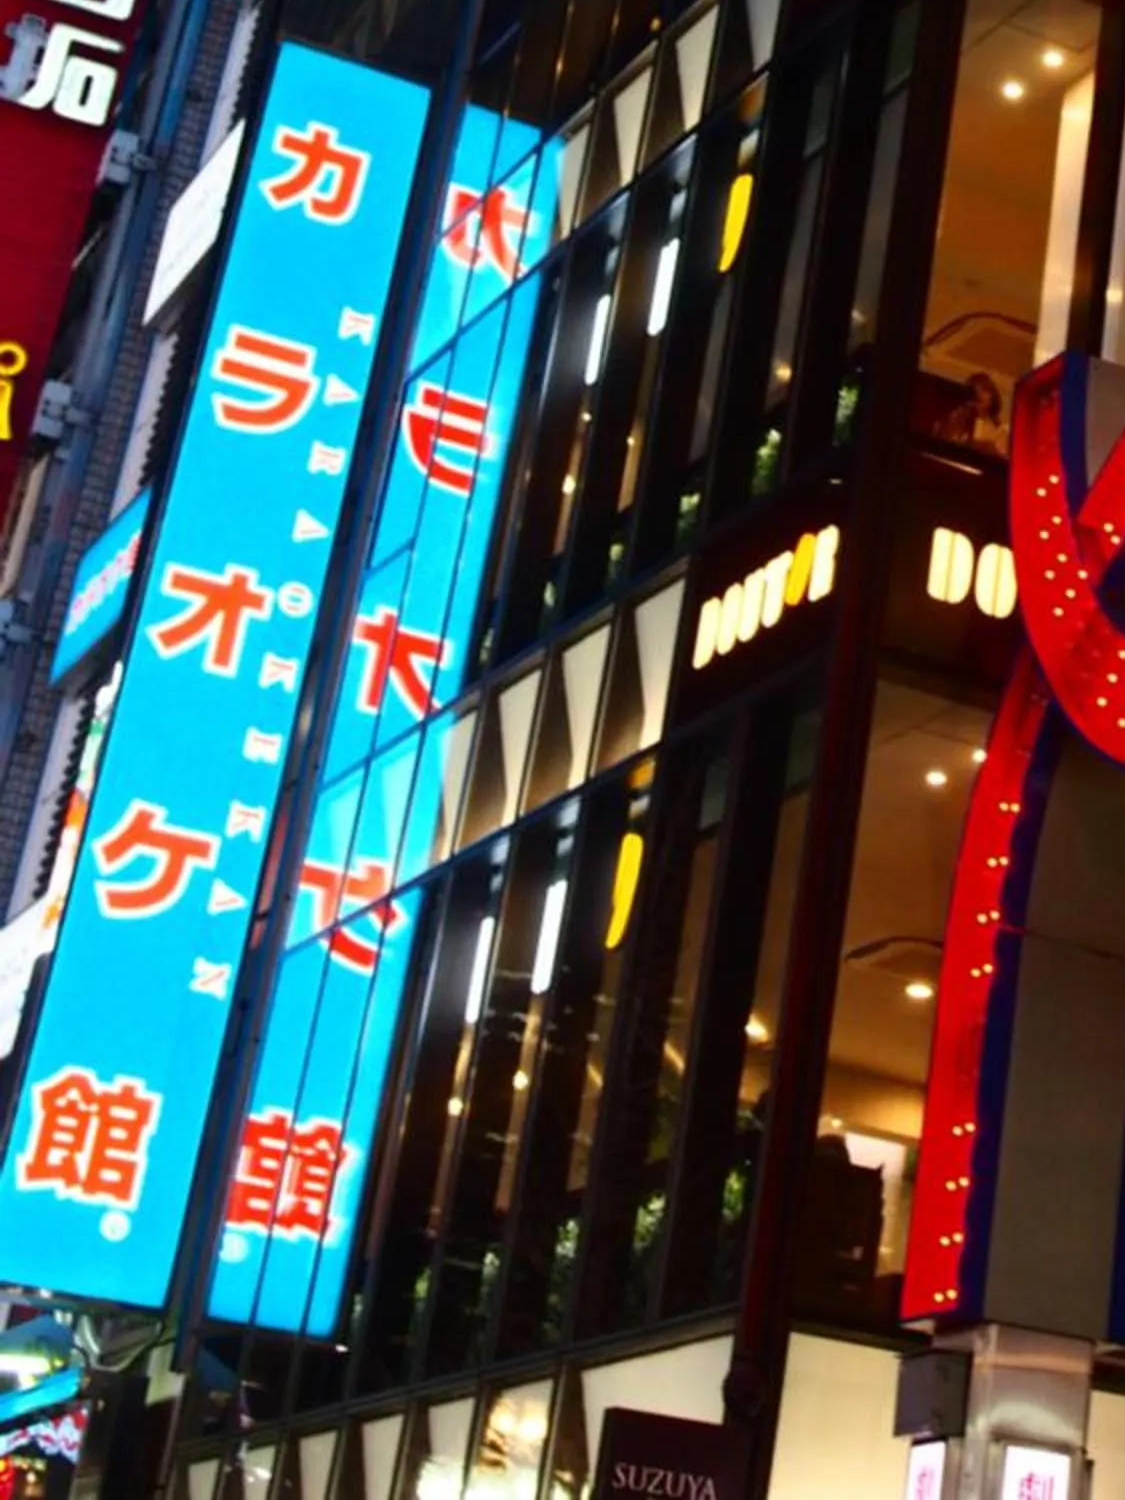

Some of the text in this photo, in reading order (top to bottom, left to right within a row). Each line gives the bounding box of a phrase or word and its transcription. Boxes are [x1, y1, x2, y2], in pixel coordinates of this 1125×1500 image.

[15, 122, 373, 1211] カラオケ館
[612, 1462, 717, 1500] SUZUYA
